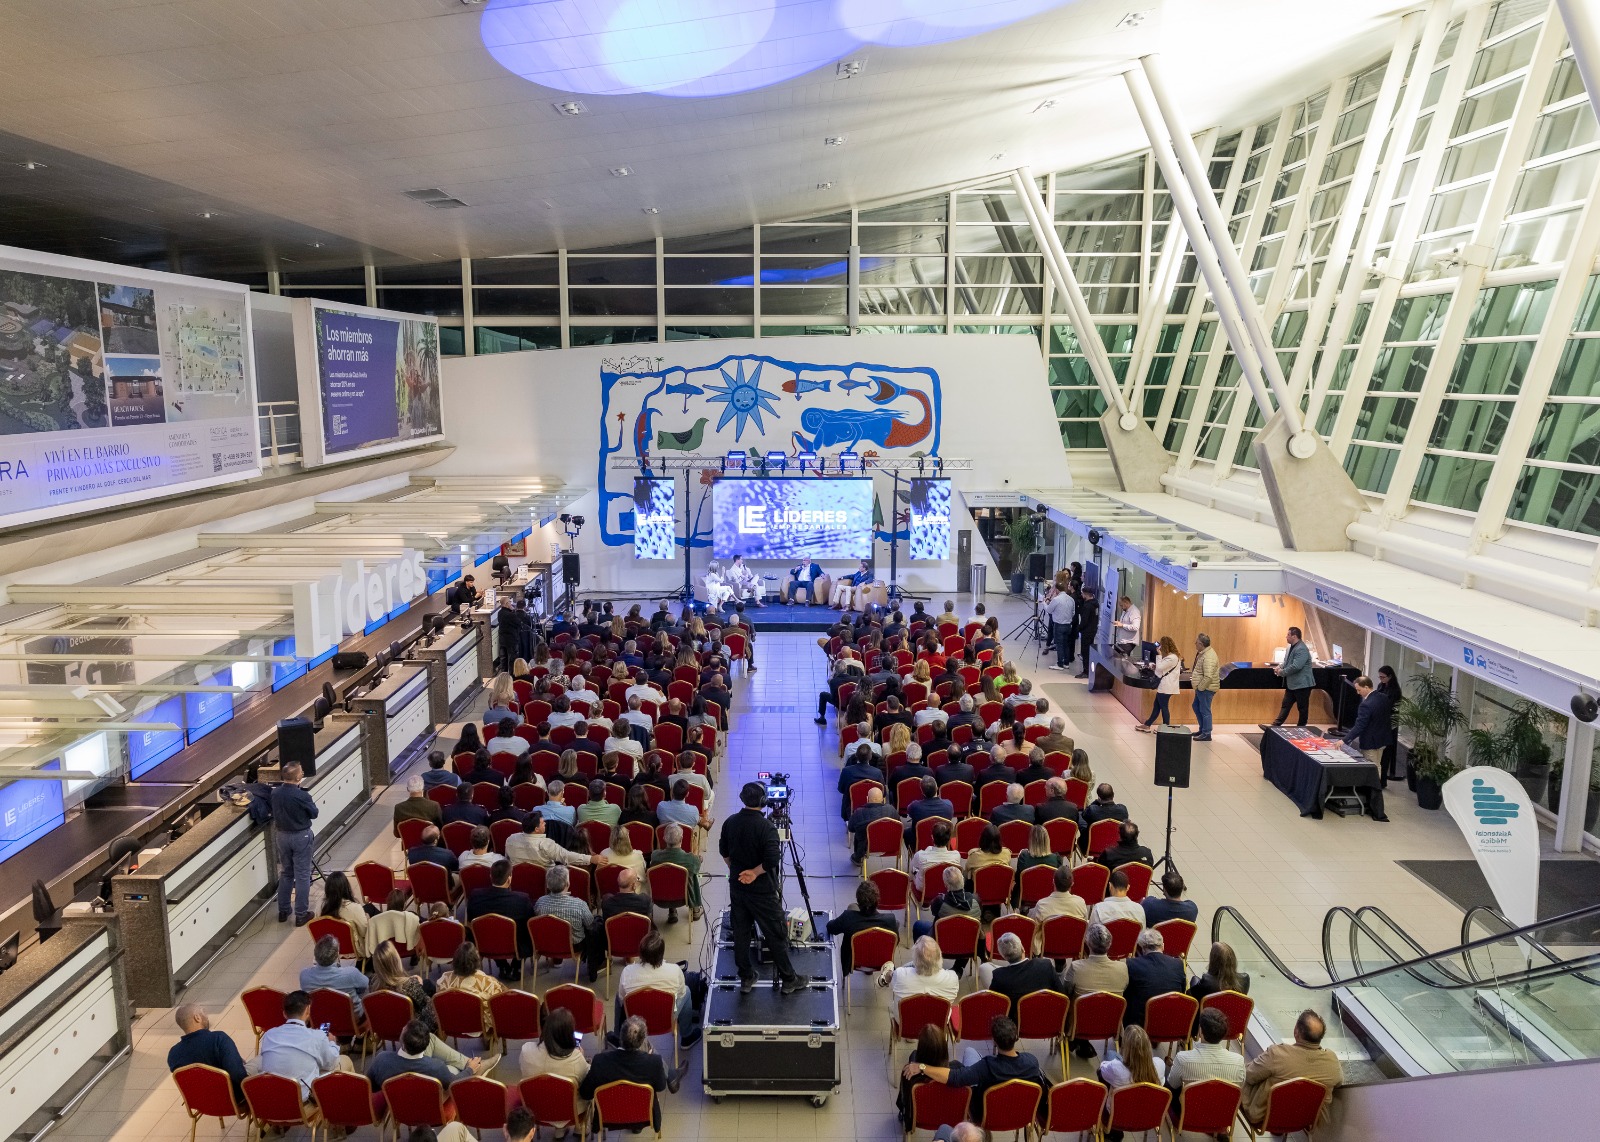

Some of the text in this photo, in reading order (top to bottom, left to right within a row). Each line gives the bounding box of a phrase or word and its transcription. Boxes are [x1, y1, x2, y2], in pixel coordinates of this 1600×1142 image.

[326, 325, 373, 344] Los miembros
[328, 345, 368, 361] ahorran más
[45, 443, 130, 463] VIVÍ EN EL BARRIO
[47, 465, 92, 482] PRIVADO
[94, 459, 114, 476] MÁS
[116, 456, 161, 473] EXCLUSIVO
[50, 486, 69, 496] FRENTE
[773, 505, 848, 523] LÍDERES
